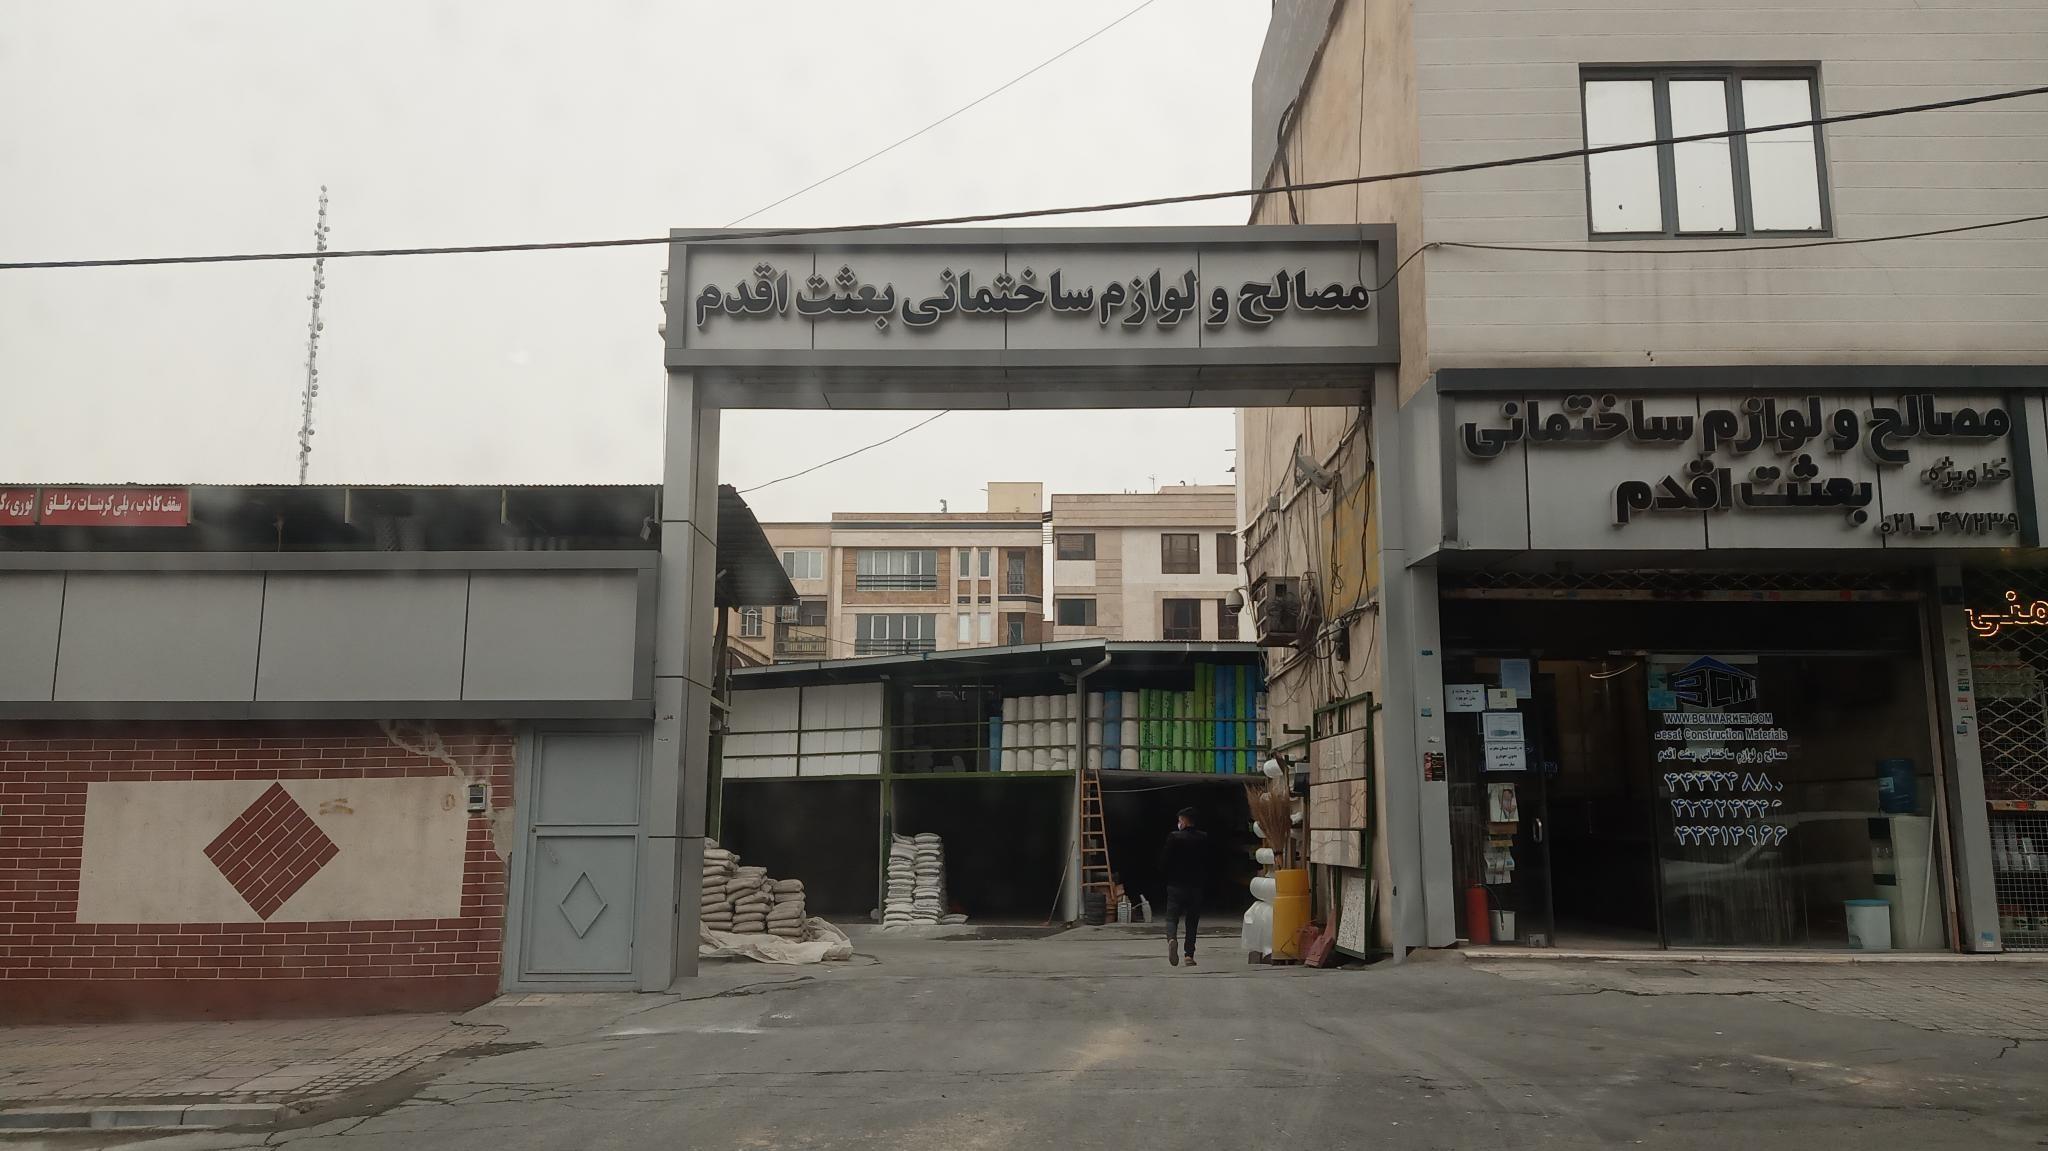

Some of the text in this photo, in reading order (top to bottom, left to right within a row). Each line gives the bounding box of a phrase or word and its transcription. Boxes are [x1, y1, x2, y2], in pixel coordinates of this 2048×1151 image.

[696, 262, 1370, 329] مصالح و لوازم ساختمانی بعثت اقدم
[1461, 394, 2011, 465] مصالح و لوازم ساختمانی
[1921, 456, 2011, 493] خط ویژه
[1612, 453, 1873, 526] بعثت اقدم
[162, 495, 182, 513] سقف
[1684, 727, 1744, 740] Construction
[1745, 727, 1788, 740] Materials
[1657, 747, 1676, 762] اقدم
[1700, 748, 1734, 763] ساختمانی
[1736, 748, 1756, 764] لوازم
[1764, 748, 1788, 761] مصالح
